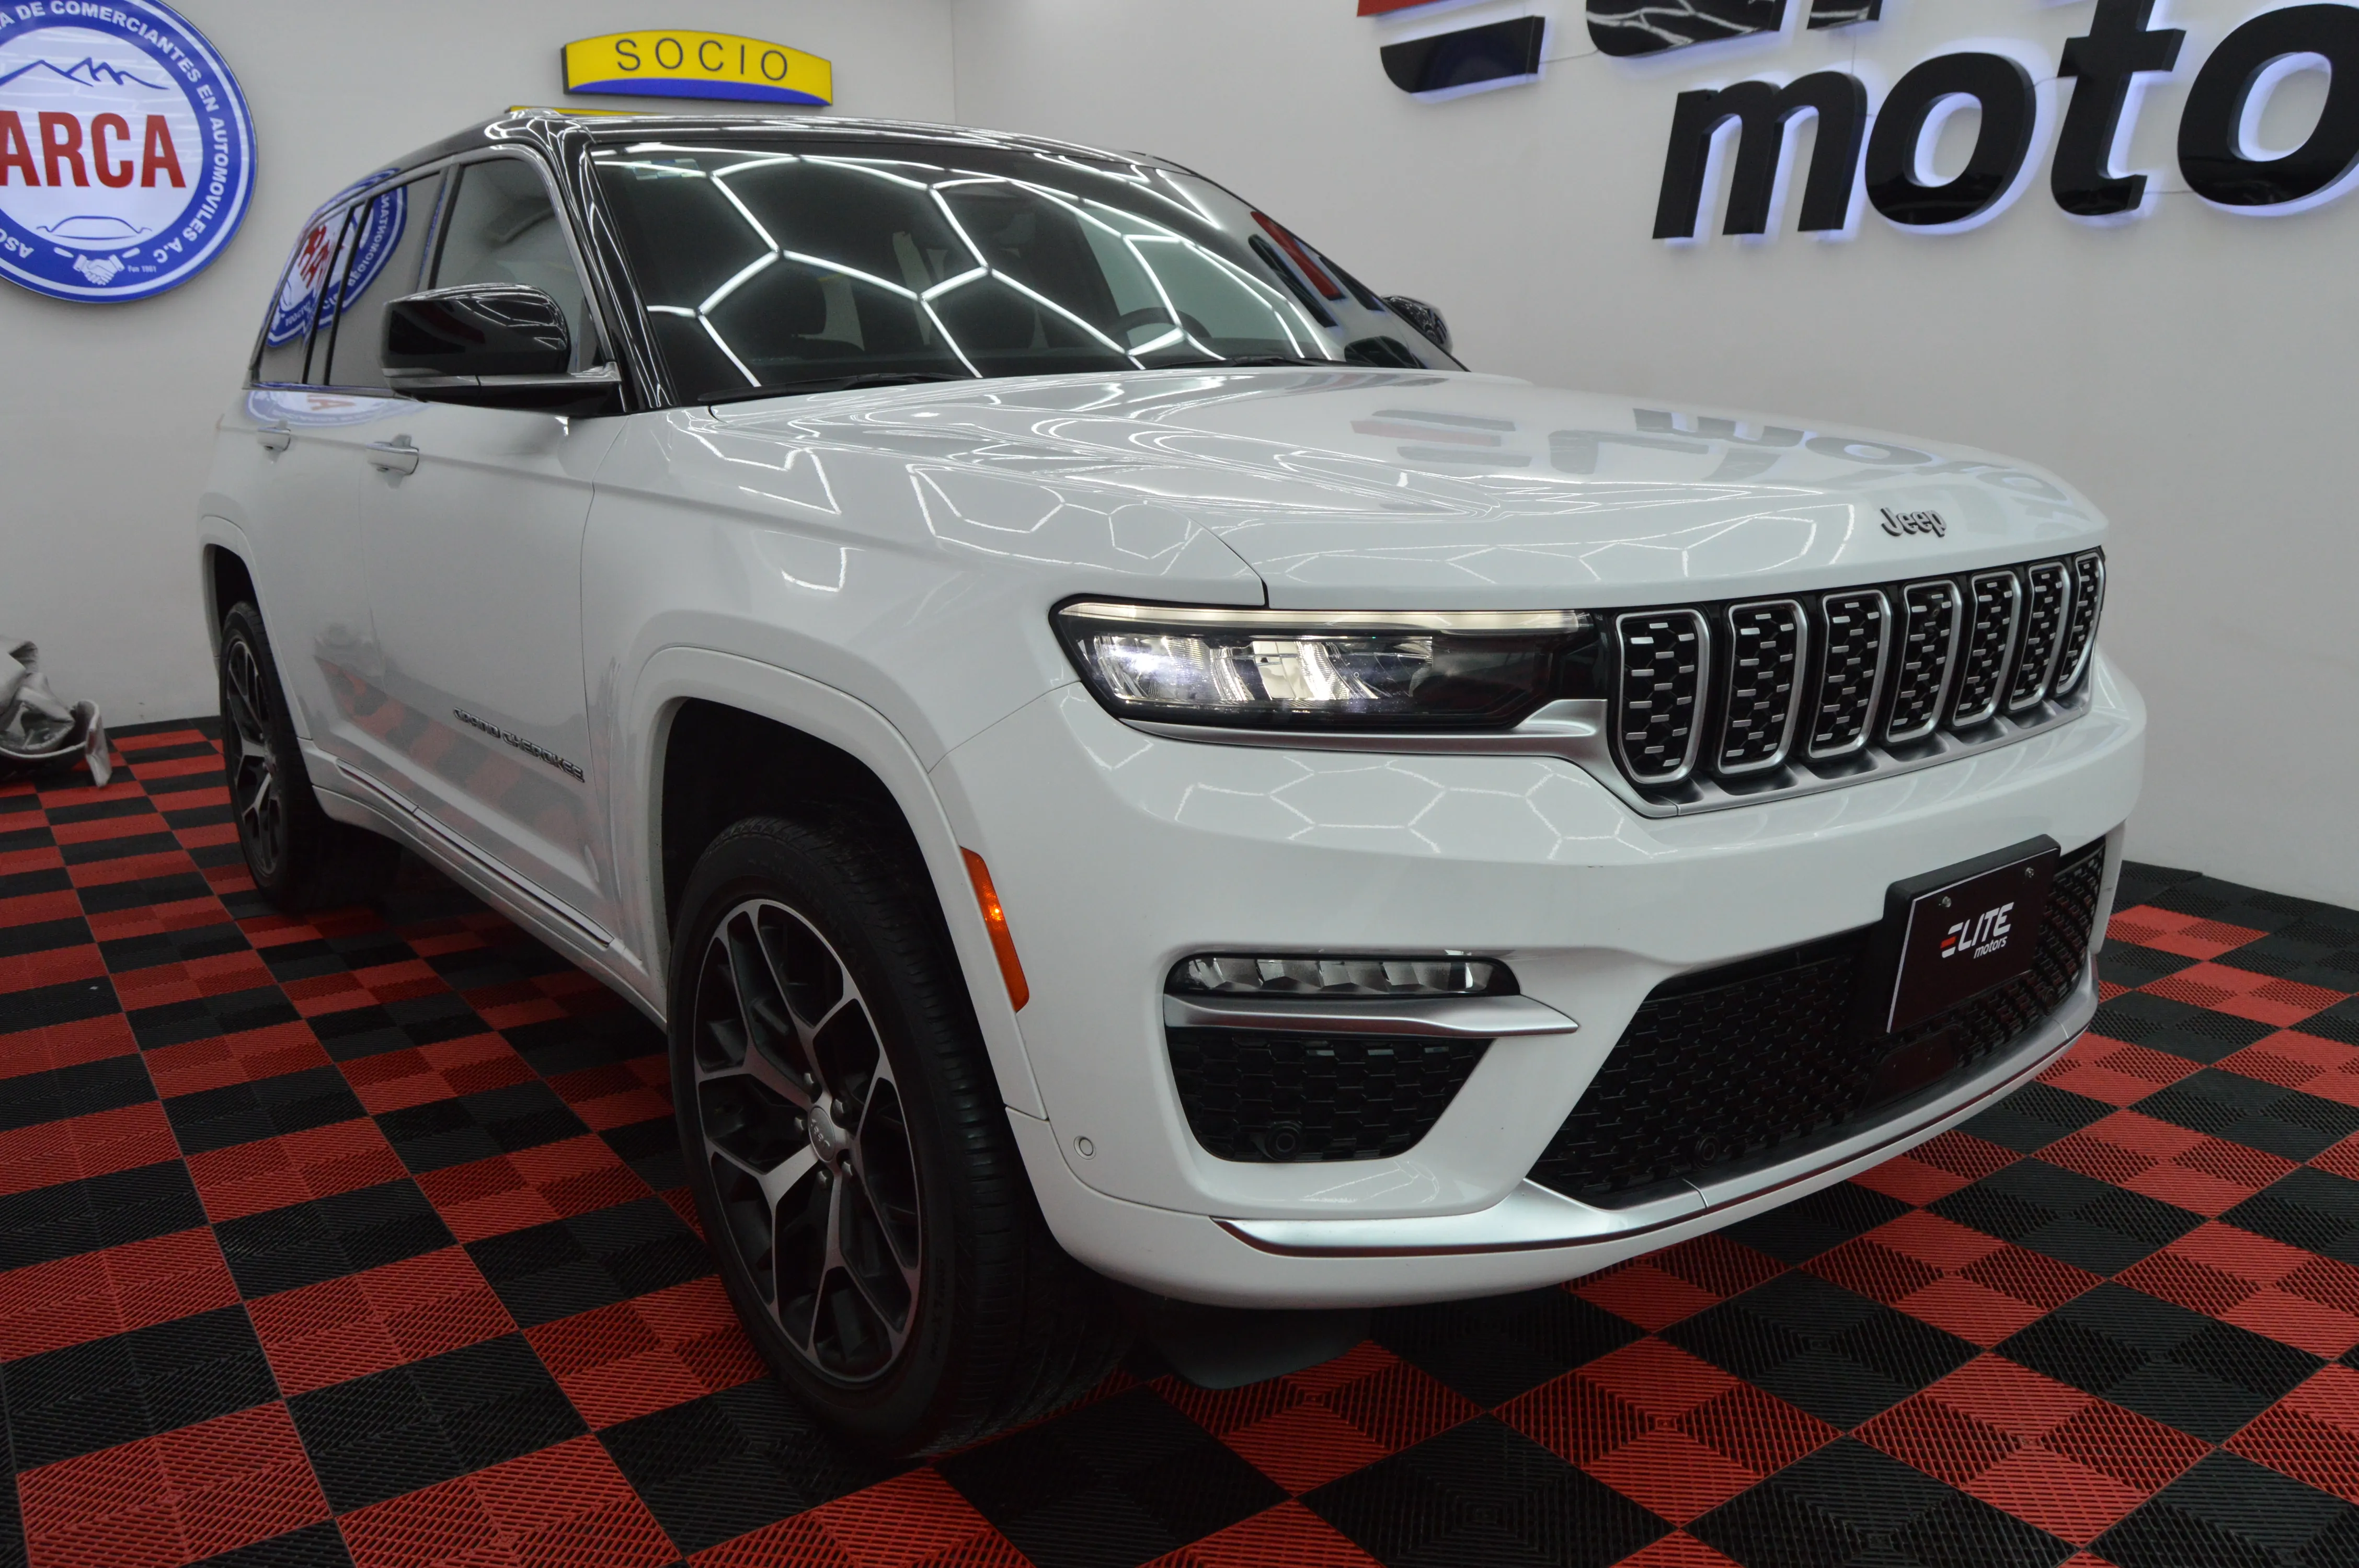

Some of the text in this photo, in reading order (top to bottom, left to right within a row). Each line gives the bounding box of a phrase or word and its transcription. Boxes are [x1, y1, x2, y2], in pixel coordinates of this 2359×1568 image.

[15, 2, 46, 20] DE
[51, 1, 202, 83] COMERCIANTES
[615, 37, 788, 81] SOCIO
[197, 84, 220, 112] EN
[0, 111, 187, 189] ARCA
[182, 117, 229, 241] AUTOMOVILES
[1880, 507, 1947, 538] Jeep
[502, 730, 585, 783] CHEROKEE
[1940, 902, 2014, 958] ELITE
[1973, 936, 2008, 959] motors
